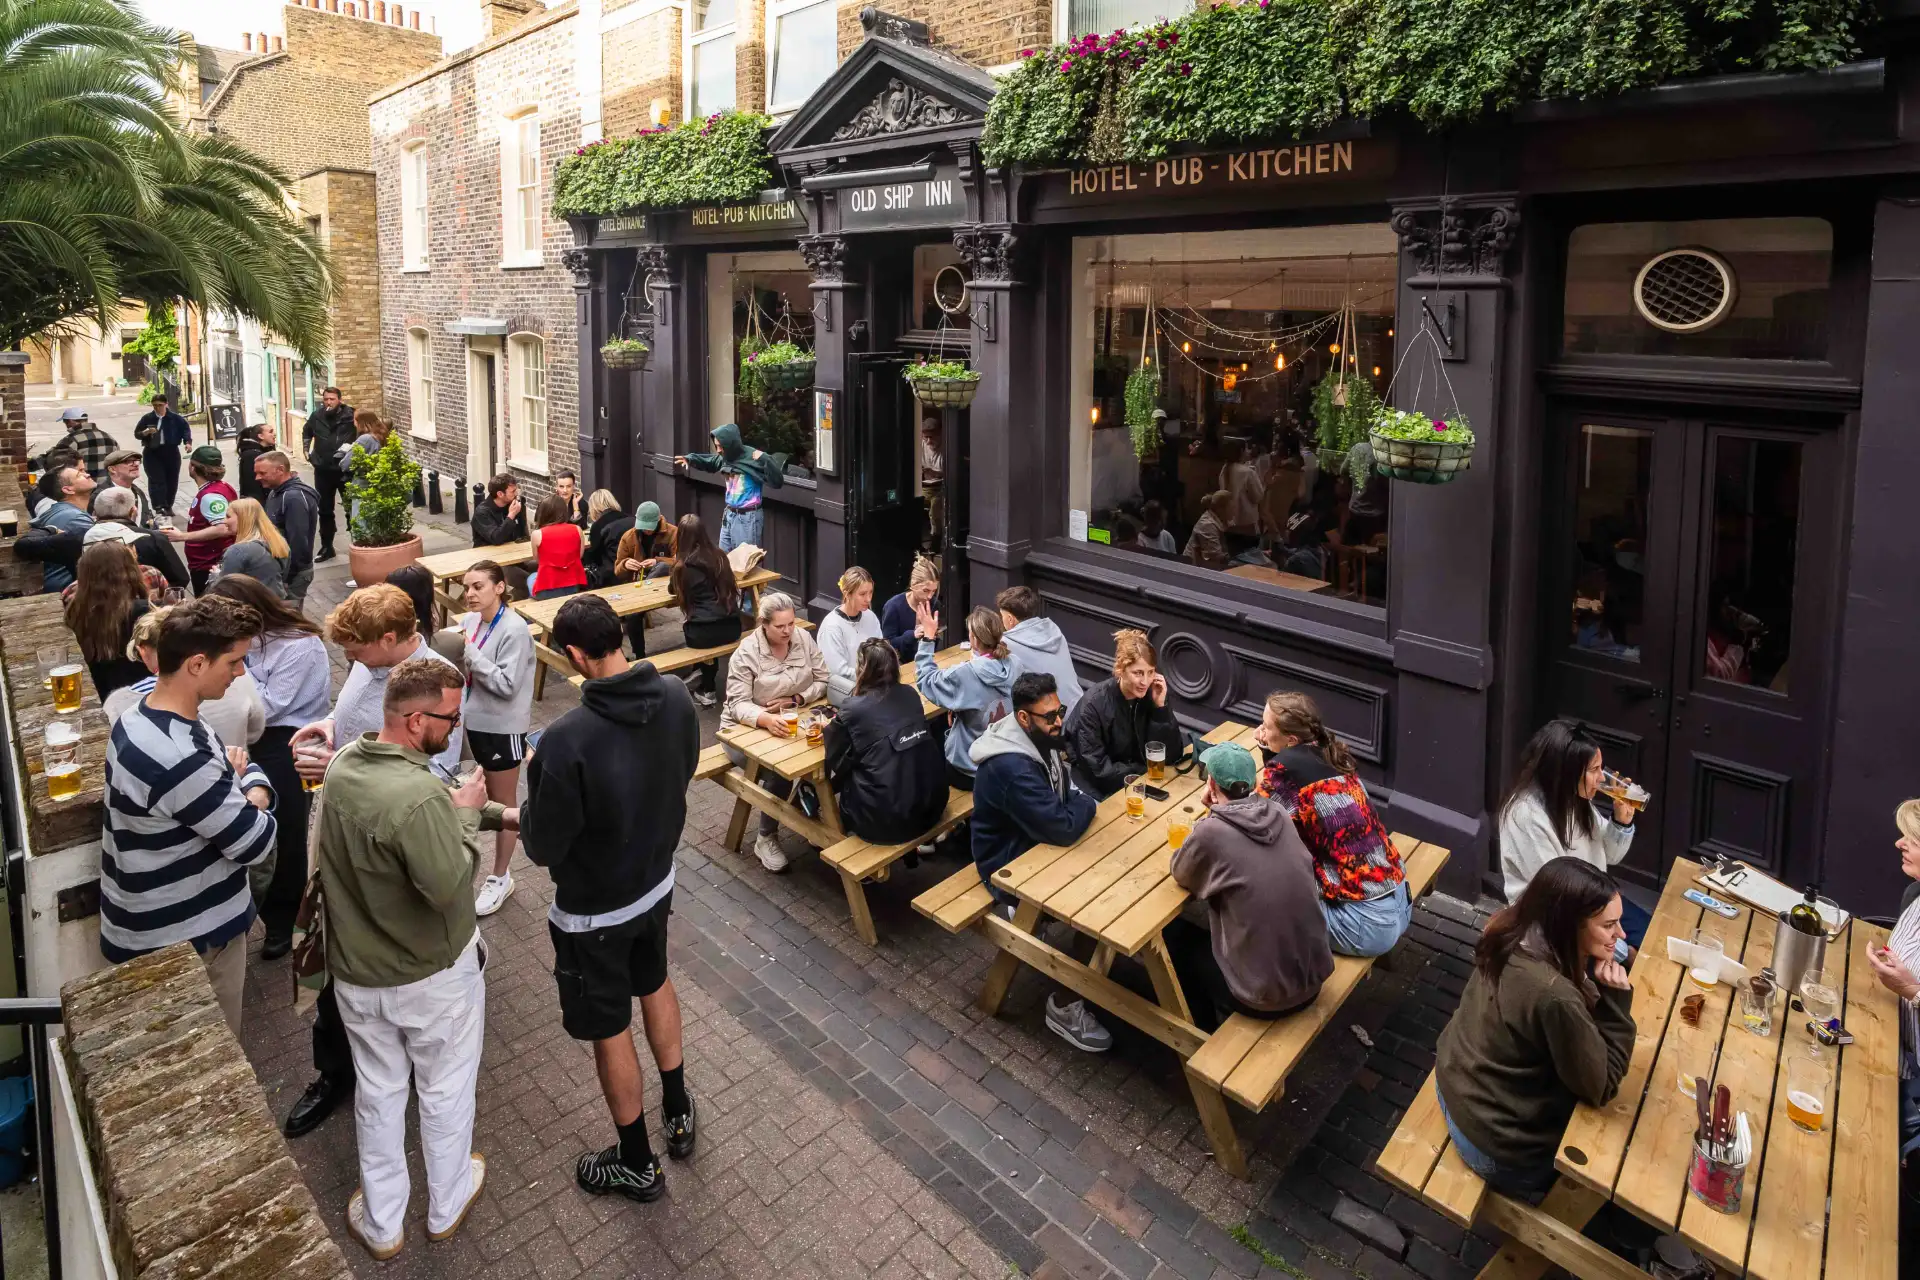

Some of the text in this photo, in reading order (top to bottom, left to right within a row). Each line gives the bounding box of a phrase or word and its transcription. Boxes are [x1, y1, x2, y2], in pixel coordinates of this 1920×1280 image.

[1070, 141, 1353, 195] HOTEL PUB KITCHEN
[851, 180, 952, 212] OLD SHIP INN
[598, 215, 646, 232] HOTEL ENTRANCE
[692, 200, 795, 226] HOTEL PUB KITCHEN
